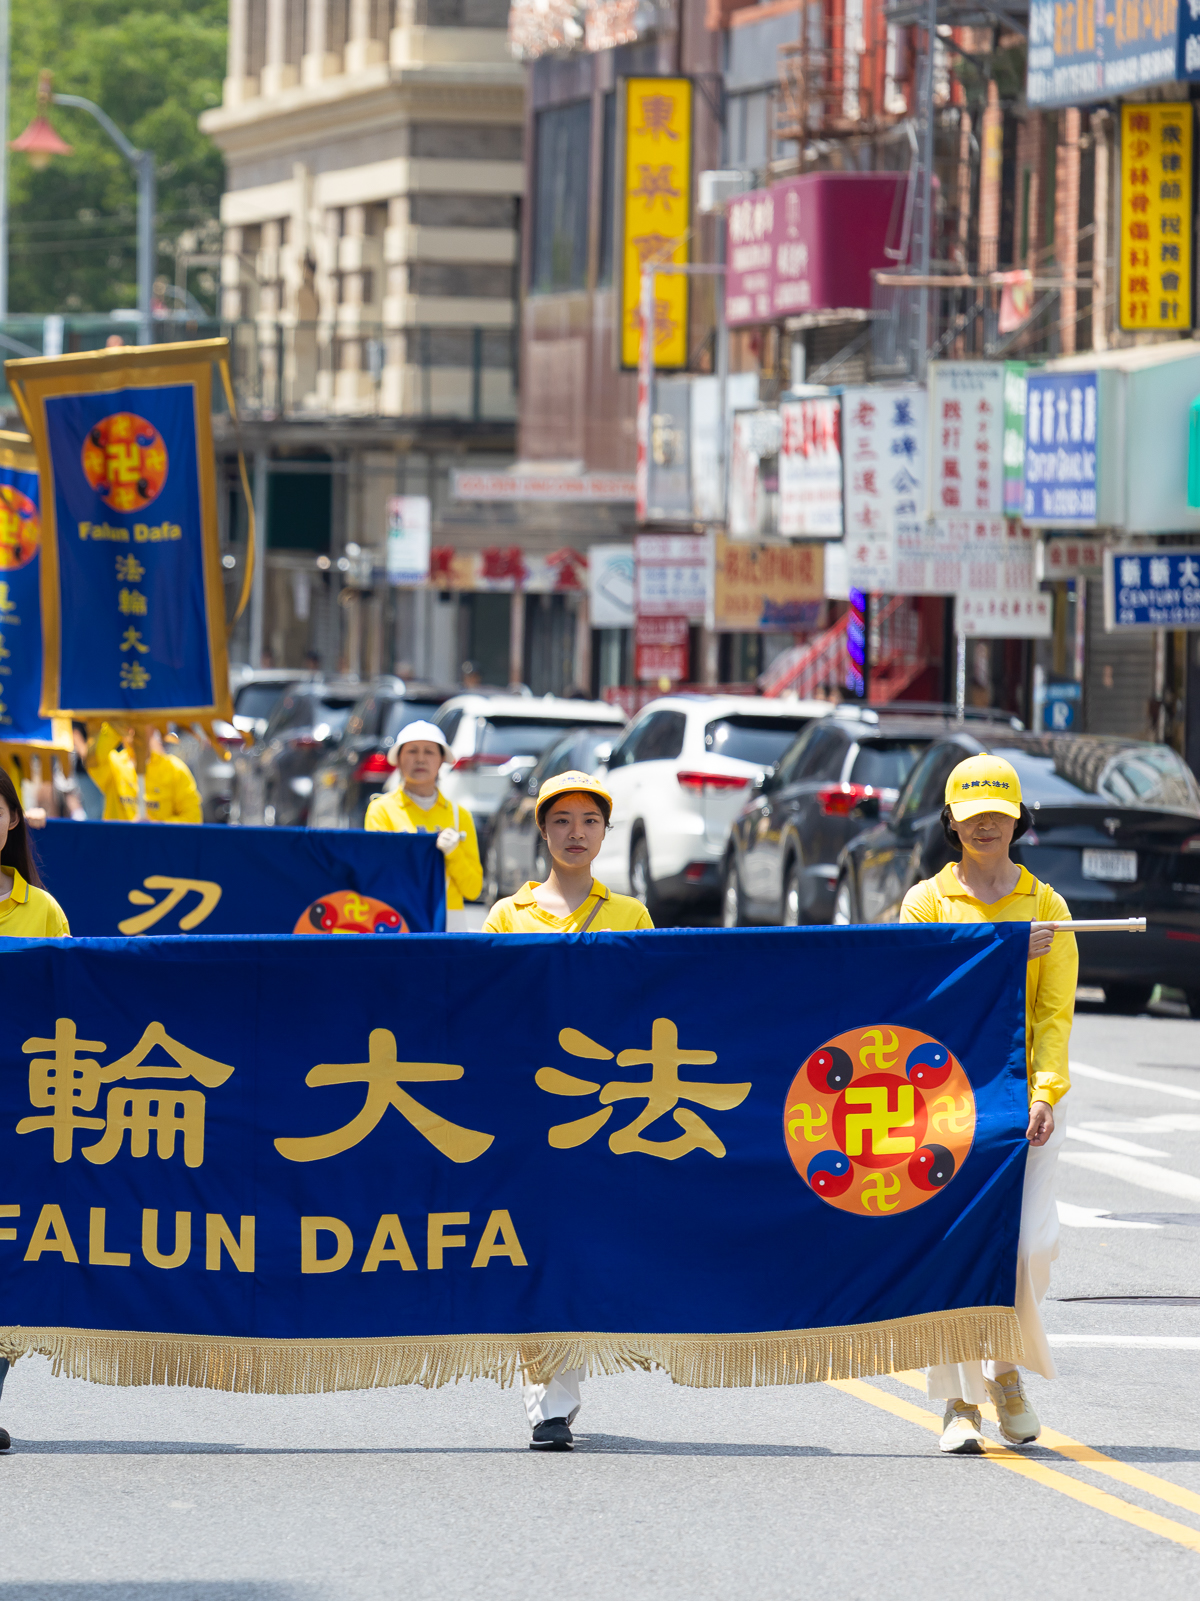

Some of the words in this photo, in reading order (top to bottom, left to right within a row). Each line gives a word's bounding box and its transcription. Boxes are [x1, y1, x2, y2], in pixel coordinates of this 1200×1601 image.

[78, 521, 130, 542] Falun
[133, 521, 182, 543] Dafa
[115, 553, 151, 690] 法輪大法
[962, 780, 1009, 789] 法輪大法好
[301, 1209, 528, 1273] DAFA
